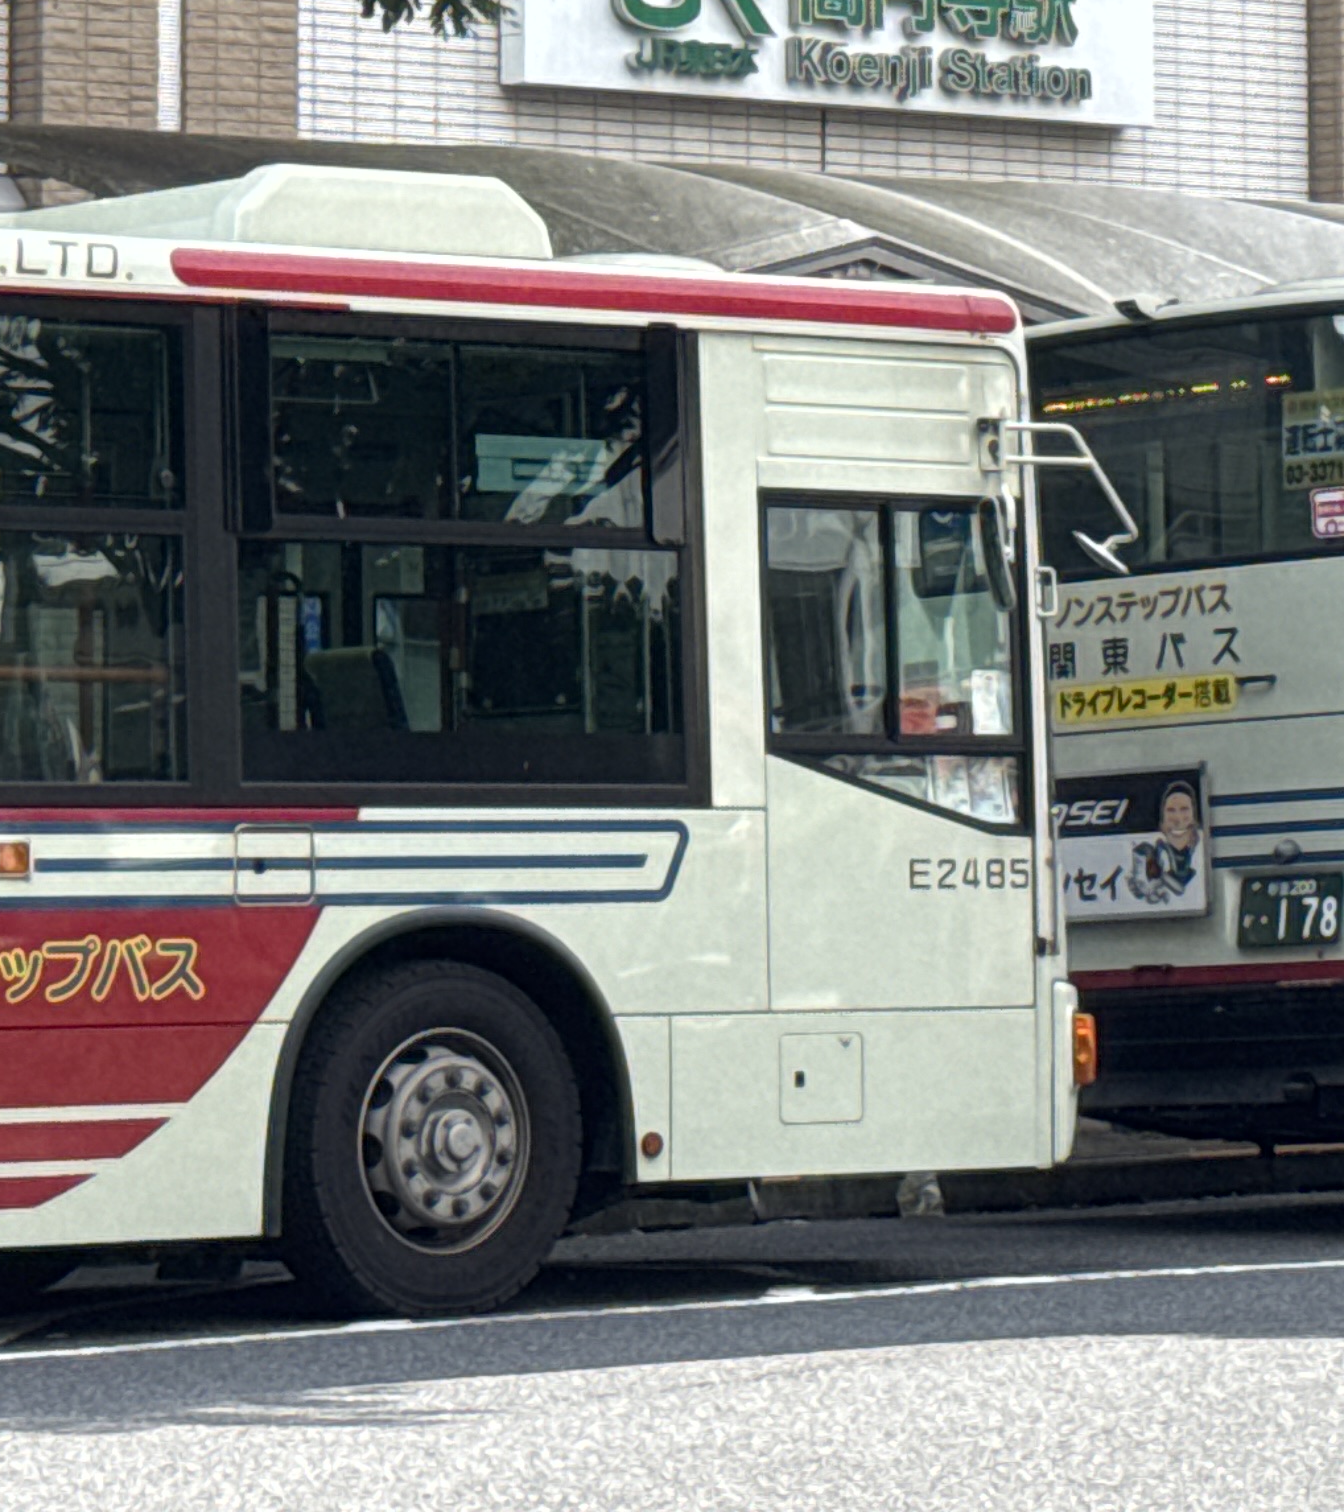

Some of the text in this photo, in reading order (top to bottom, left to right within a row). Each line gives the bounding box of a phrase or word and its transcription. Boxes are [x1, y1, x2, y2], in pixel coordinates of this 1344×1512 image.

[786, 37, 1092, 101] Koenji Station
[1055, 584, 1232, 629] ノンステップバス
[1060, 677, 1232, 719] ドライブレコーダー搭載
[909, 857, 1029, 890] E2485
